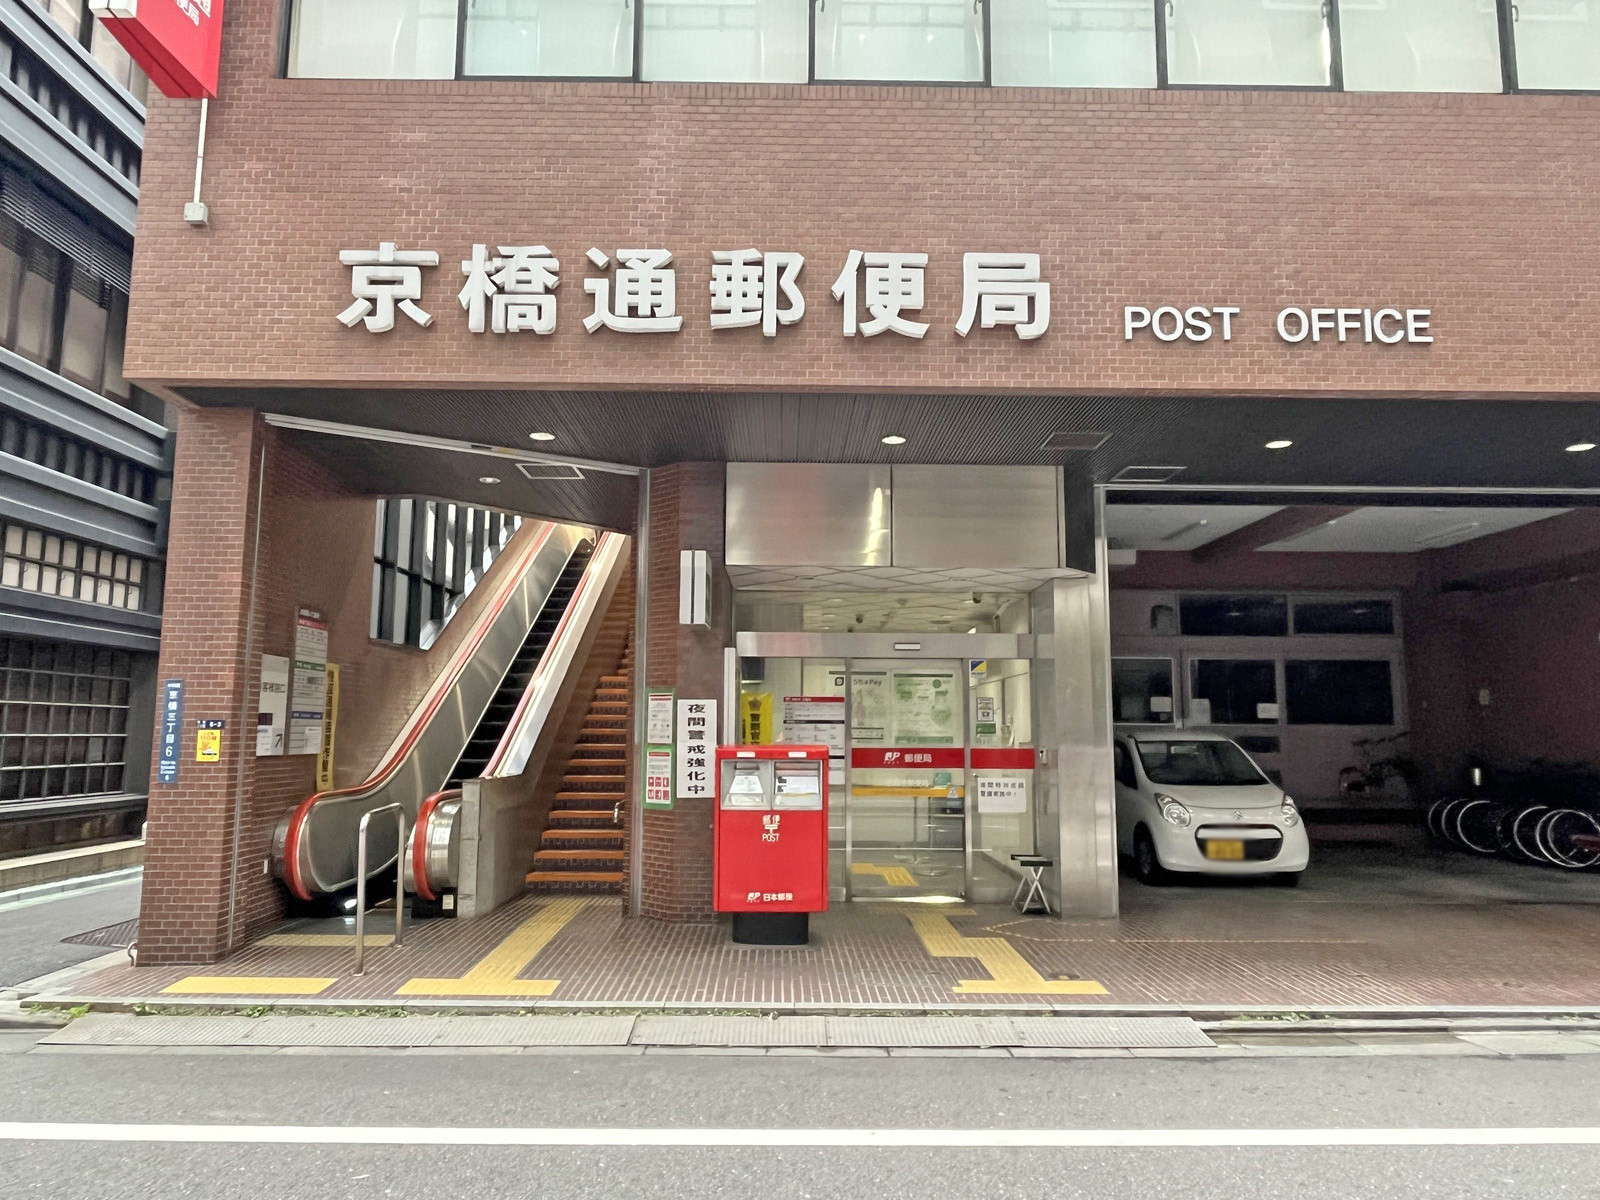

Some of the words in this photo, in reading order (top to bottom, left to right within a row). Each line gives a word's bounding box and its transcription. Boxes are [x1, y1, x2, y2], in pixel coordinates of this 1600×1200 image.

[336, 242, 1051, 340] 京橋通郵便局
[1124, 306, 1240, 342] POST
[1276, 307, 1434, 344] OFFICE
[687, 703, 706, 794] 夜間警戒強化中
[904, 753, 933, 763] 郵便局
[762, 833, 780, 842] POST
[763, 892, 793, 902] 日本郵便
